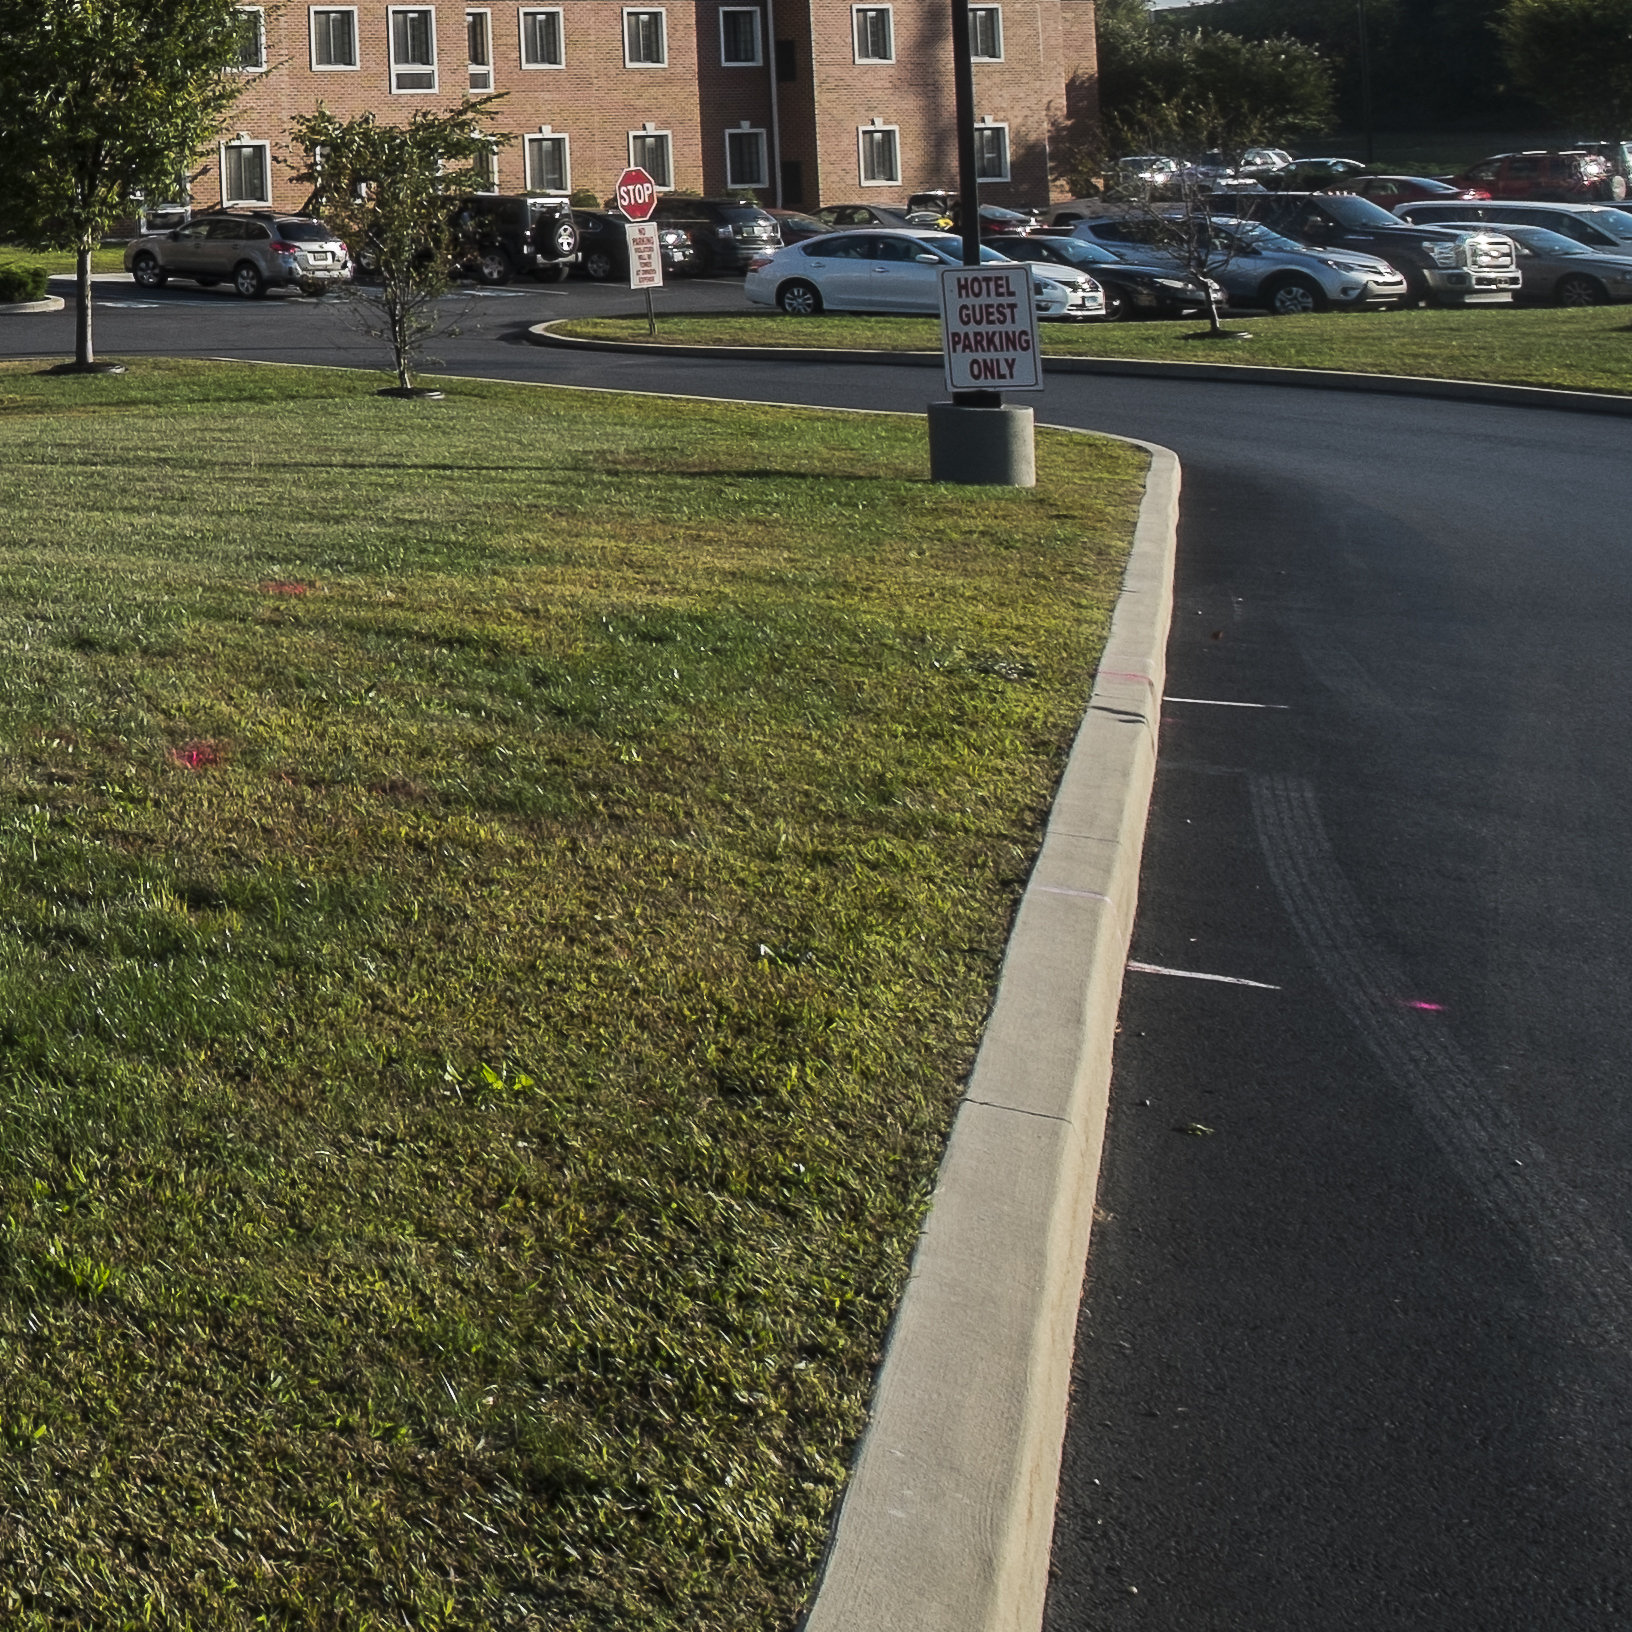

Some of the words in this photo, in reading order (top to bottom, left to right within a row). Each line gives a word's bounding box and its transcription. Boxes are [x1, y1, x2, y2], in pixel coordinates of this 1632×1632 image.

[620, 182, 653, 206] STOP
[956, 275, 1017, 299] HOTEL
[958, 302, 1018, 326] GUEST
[950, 329, 1031, 354] PARKING
[969, 357, 1017, 381] ONLY
